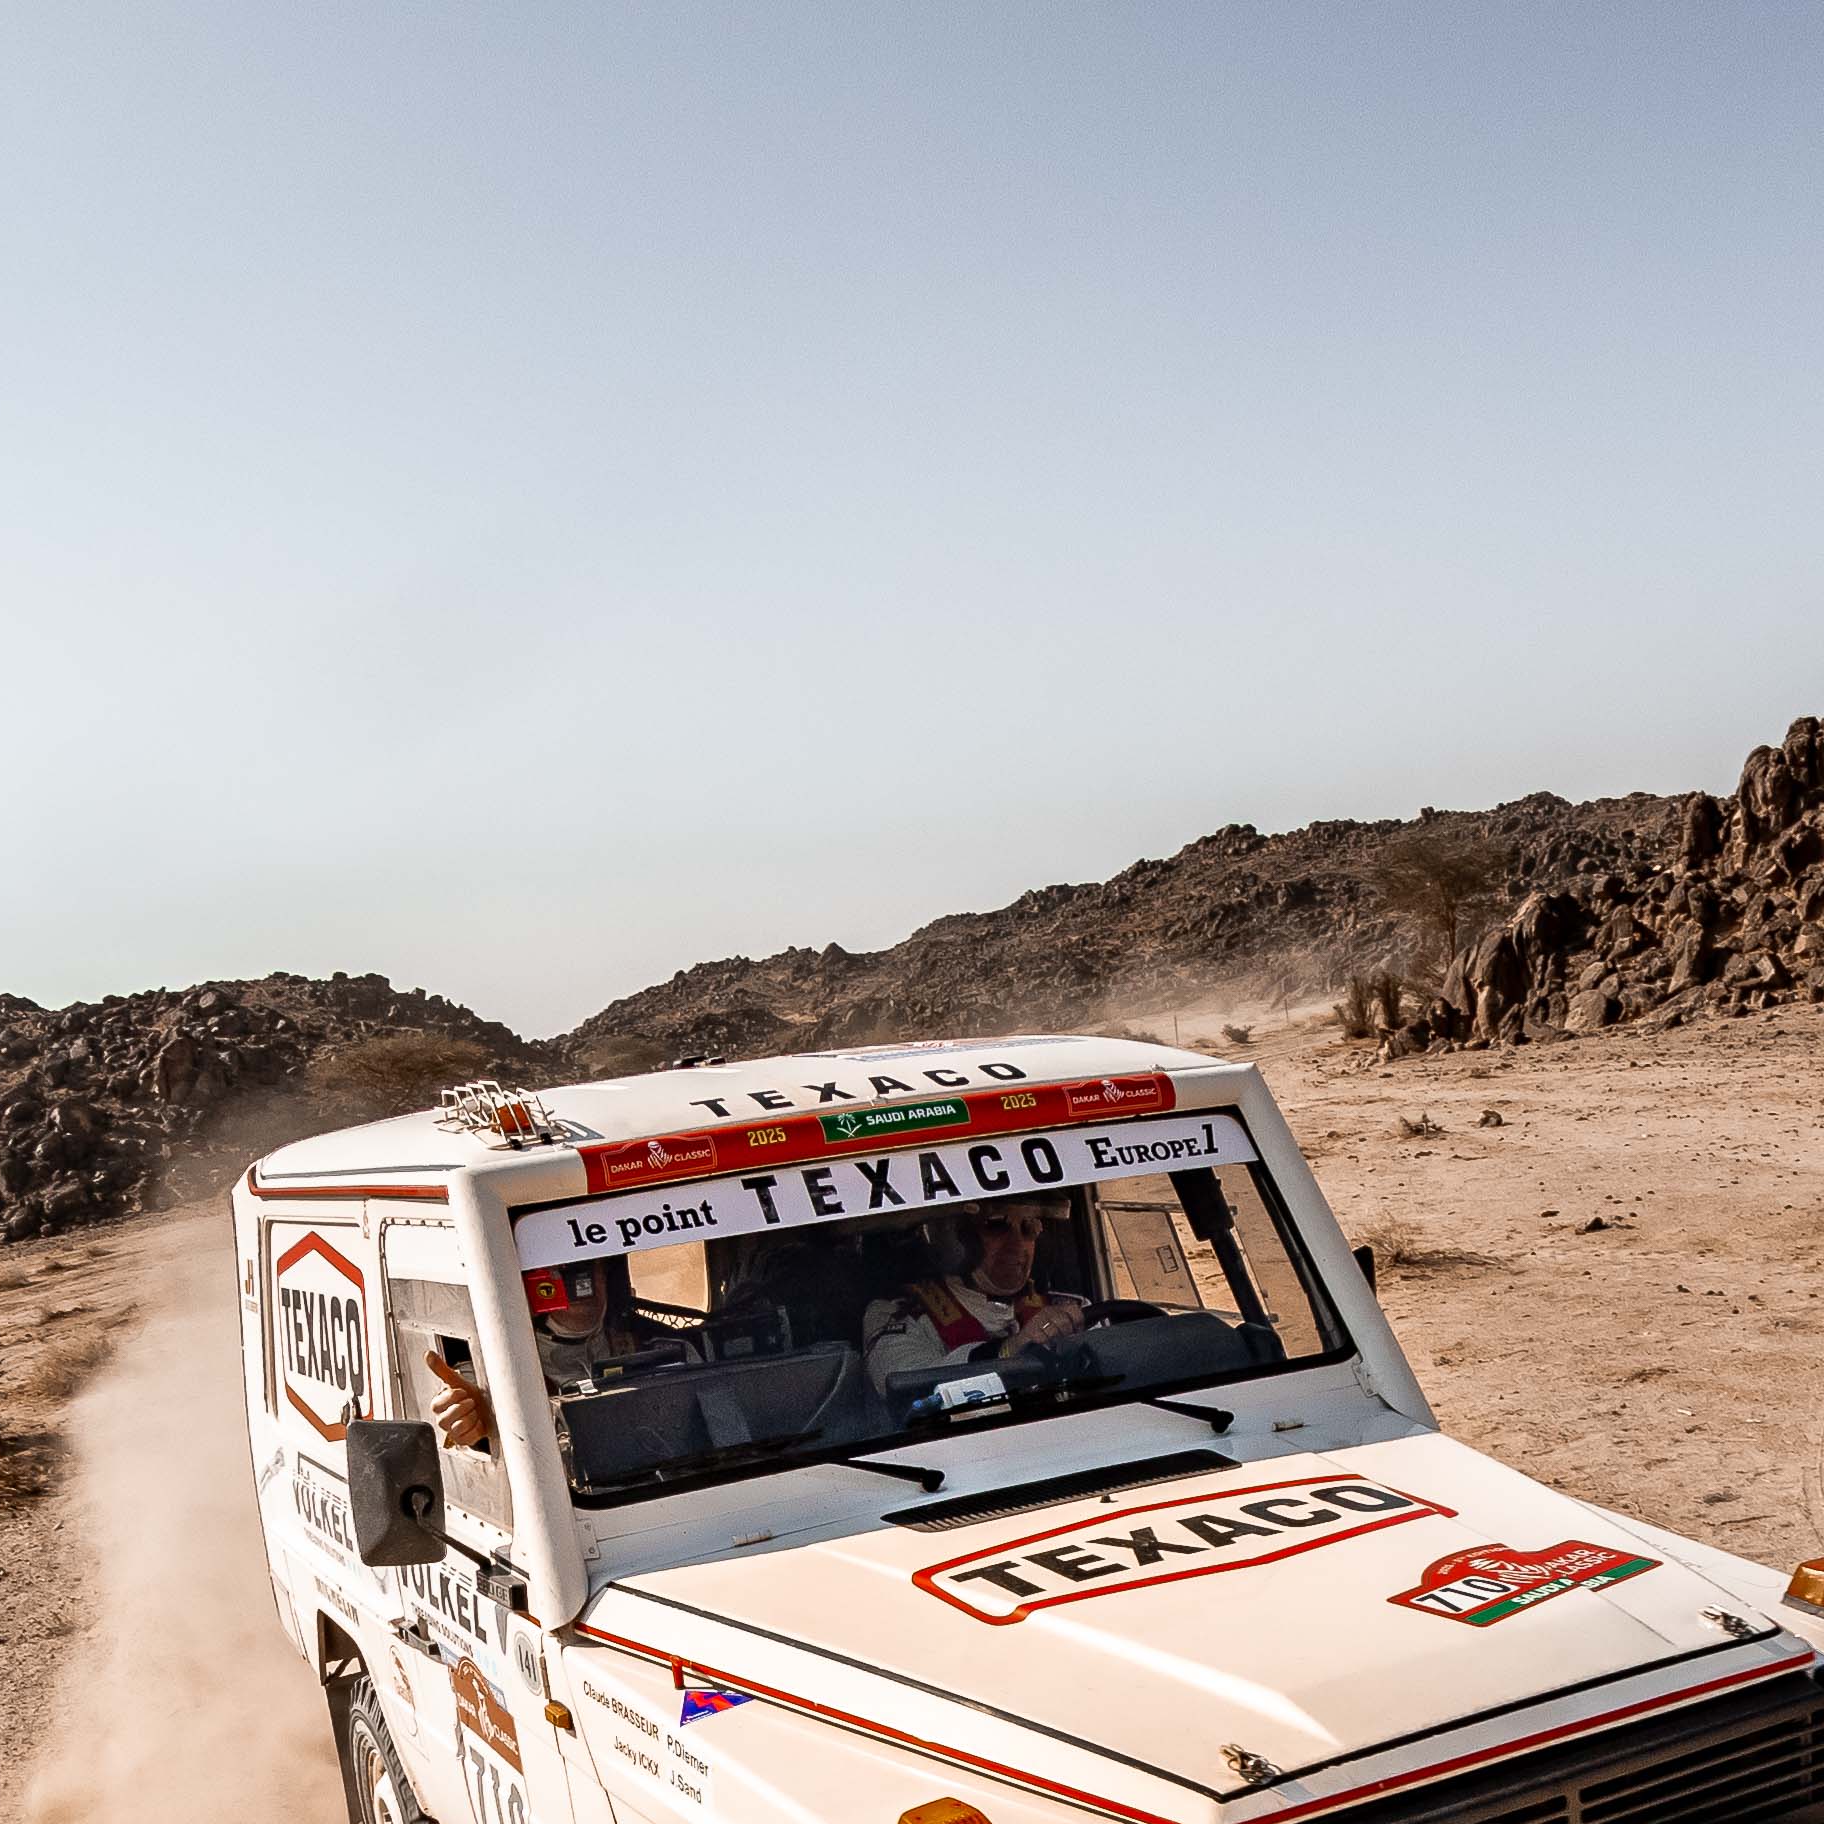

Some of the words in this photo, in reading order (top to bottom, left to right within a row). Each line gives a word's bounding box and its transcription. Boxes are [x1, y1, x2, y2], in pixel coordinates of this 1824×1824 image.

[690, 1062, 1028, 1118] TEXACO
[1001, 1093, 1037, 1111] 2025
[1072, 1093, 1100, 1105] DAKAR
[1125, 1087, 1157, 1098] CLASSIC
[866, 1110, 905, 1127] SAUDI
[908, 1103, 957, 1121] ARABIA
[748, 1127, 786, 1148] 2025
[610, 1160, 644, 1175] DAKAR
[674, 1147, 712, 1162] CLASSIC
[740, 1137, 1064, 1225] TEXACO
[567, 1218, 608, 1248] le
[615, 1199, 718, 1248] point
[281, 1287, 365, 1397] TEXACO
[949, 1484, 1415, 1598] TEXACO
[1416, 1578, 1512, 1613] 710
[518, 1644, 538, 1682] 141
[583, 1680, 610, 1709] Claude
[611, 1697, 660, 1742] BRASSEUR
[614, 1735, 637, 1766] Jacky
[639, 1752, 660, 1779] ICKX
